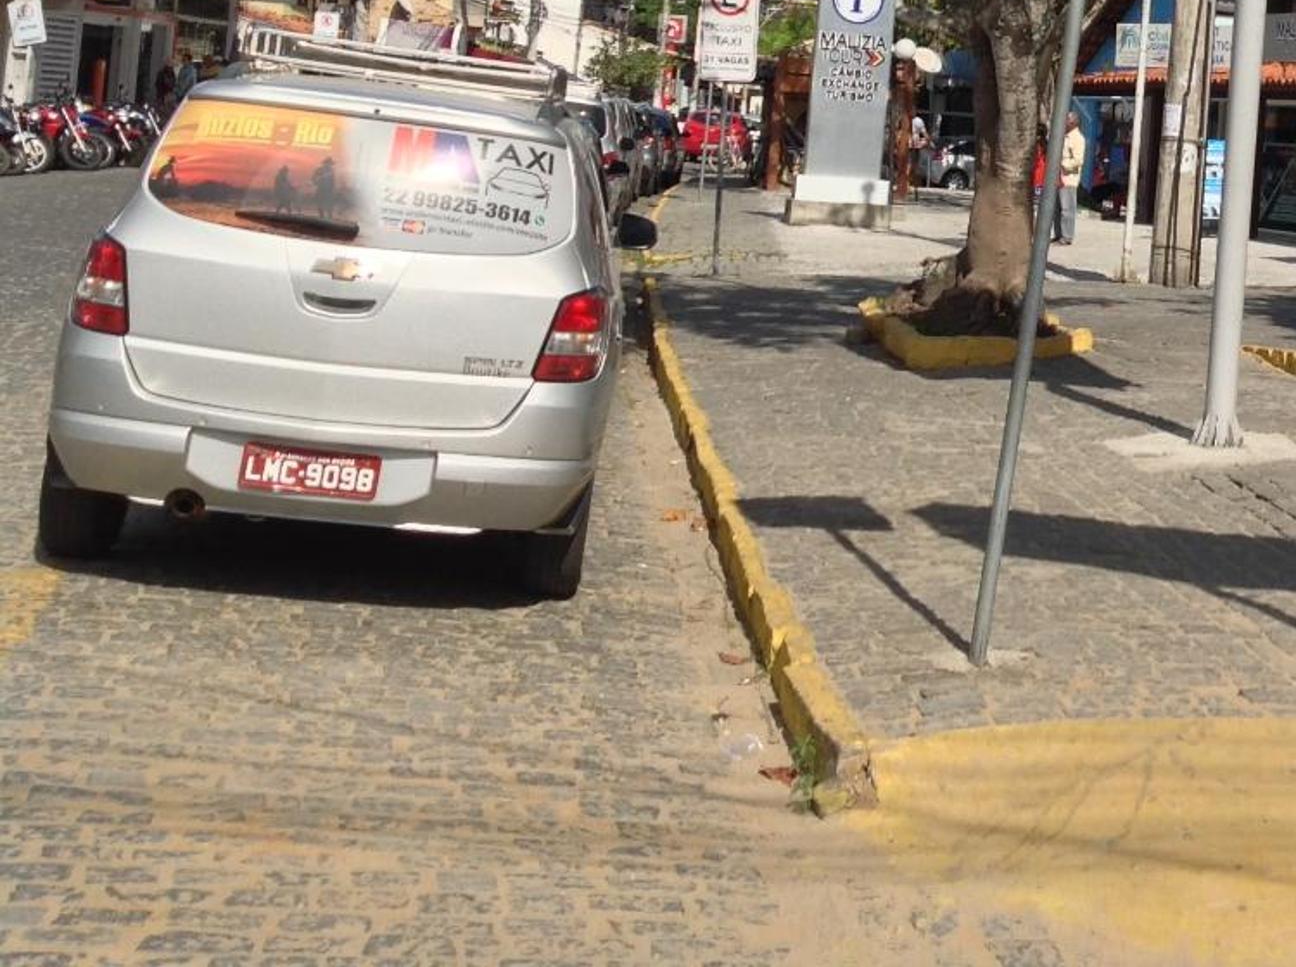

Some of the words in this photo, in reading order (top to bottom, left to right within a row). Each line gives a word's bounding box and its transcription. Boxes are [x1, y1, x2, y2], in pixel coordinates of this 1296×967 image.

[820, 32, 888, 51] MALIZIA
[822, 48, 862, 66] TOUR
[822, 79, 880, 92] EXCHANGE
[477, 137, 555, 176] TAXI
[412, 189, 531, 226] 99825-3614
